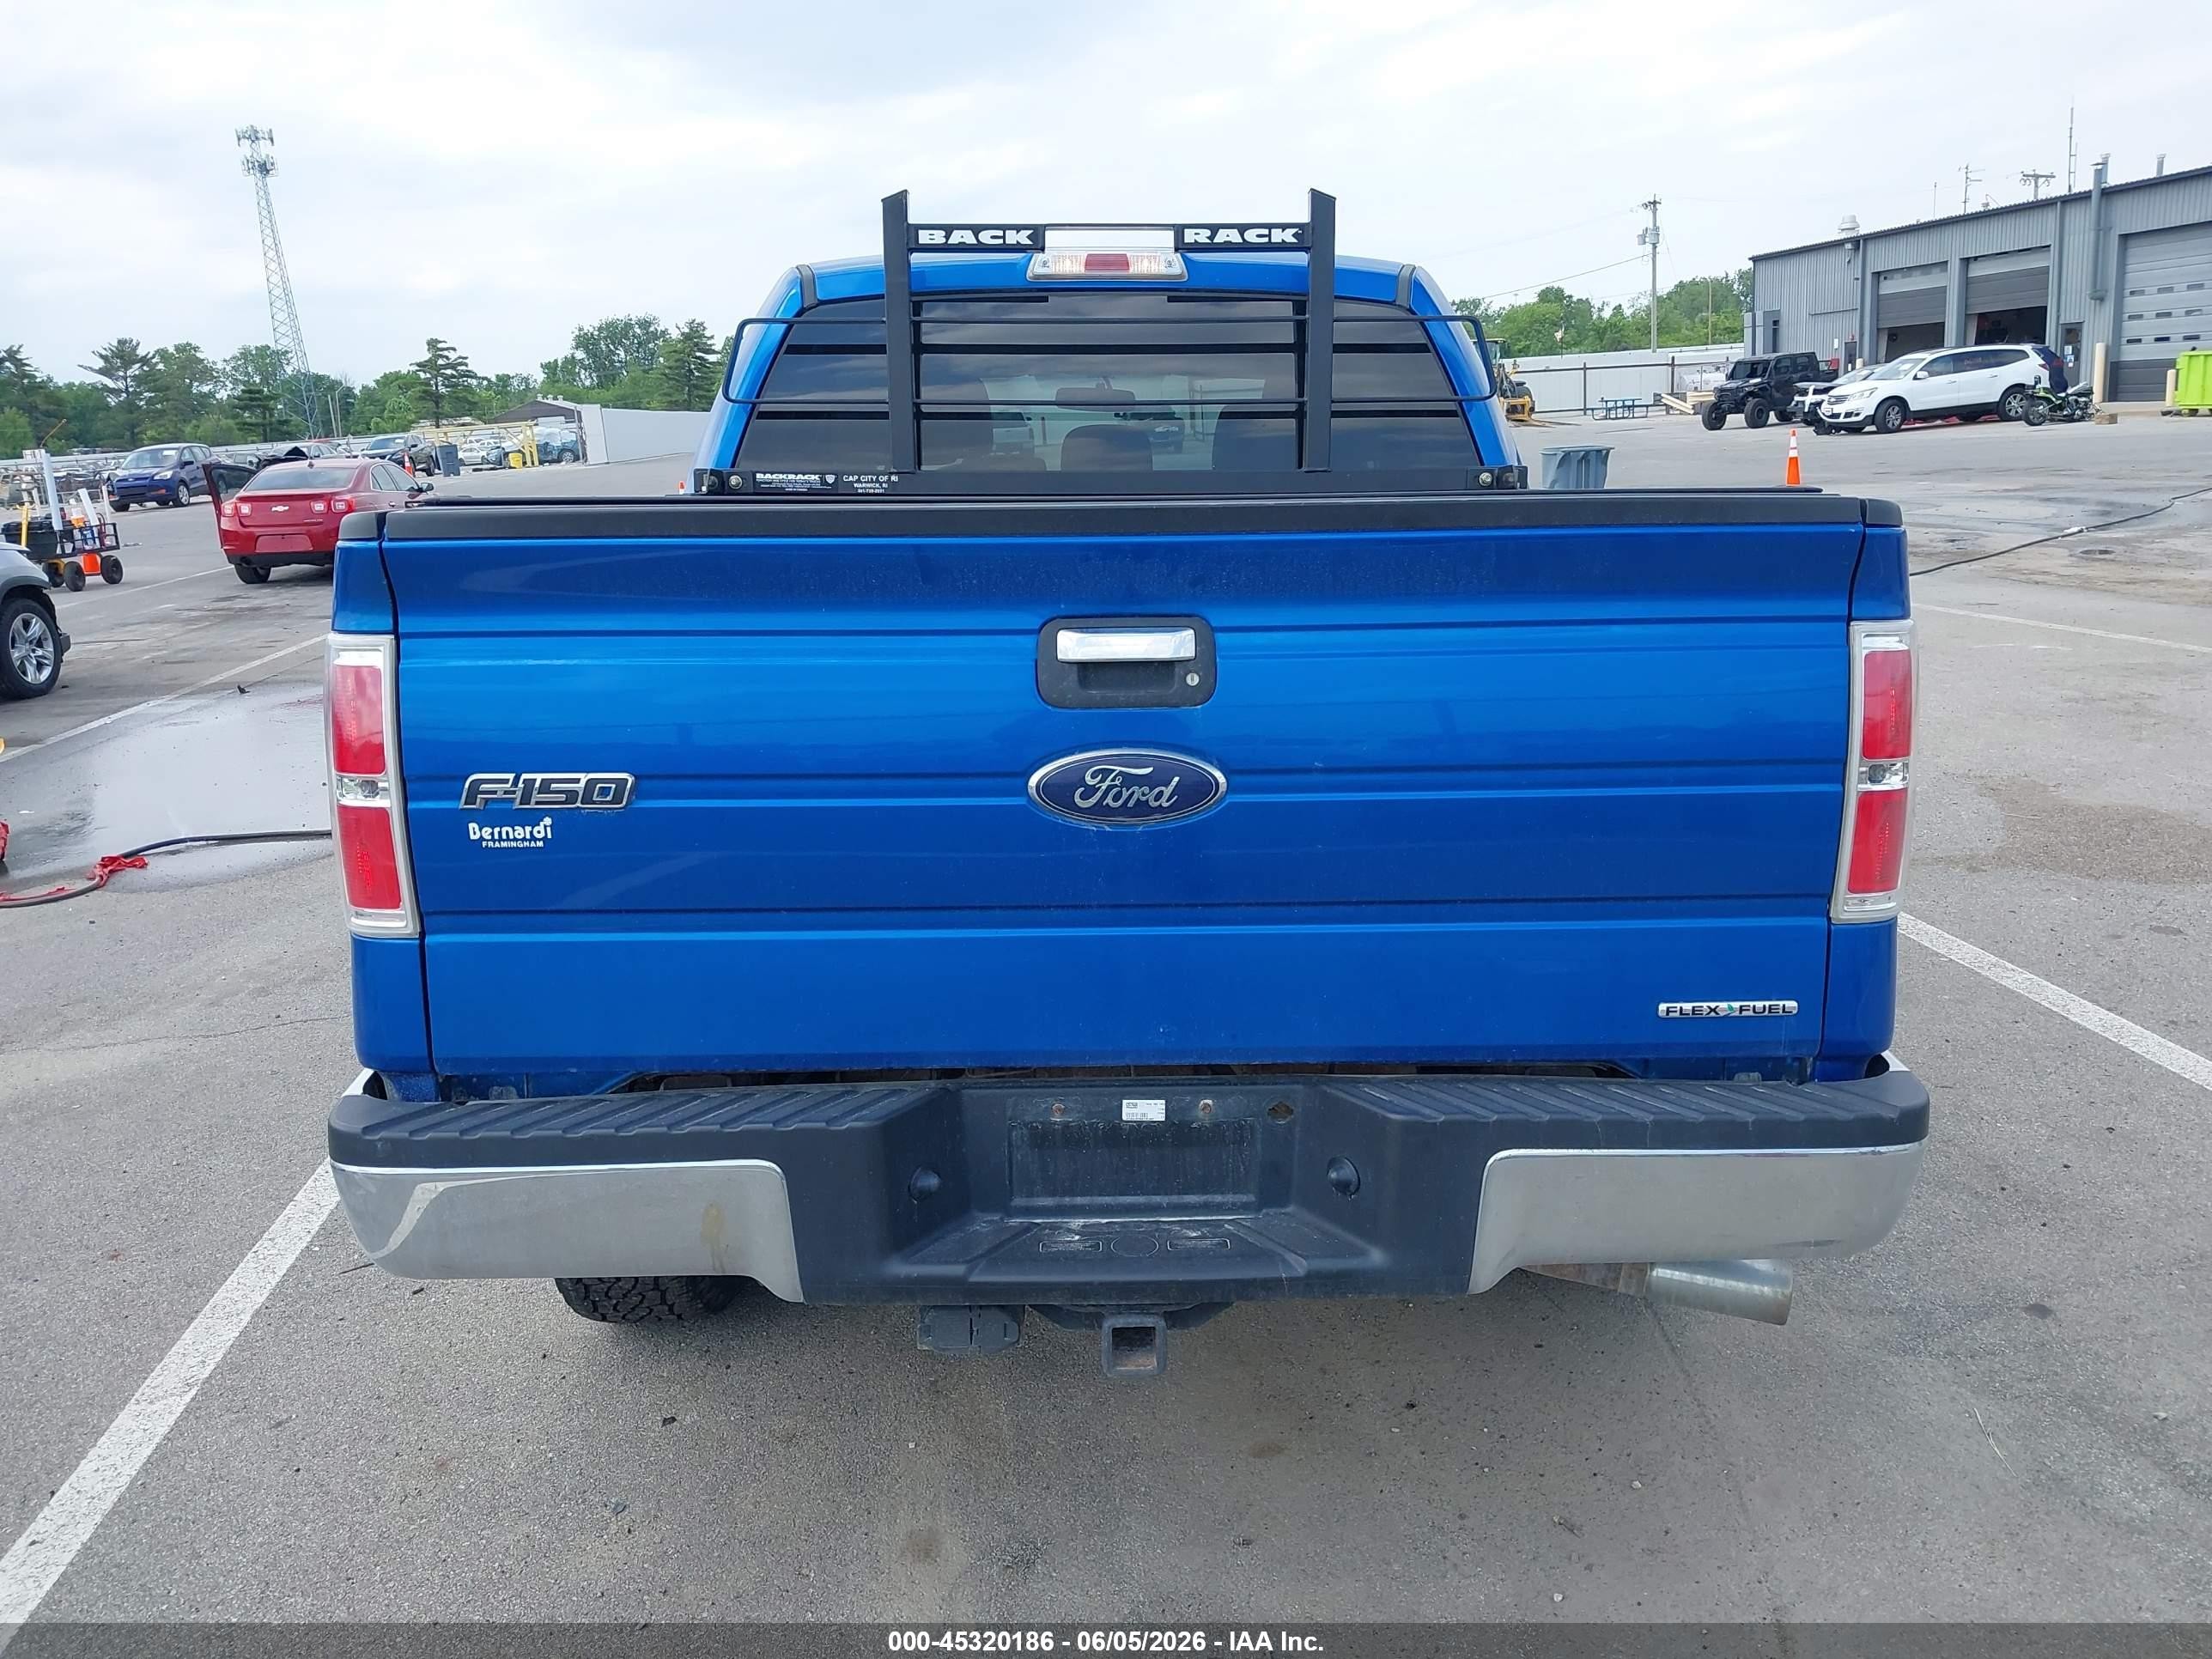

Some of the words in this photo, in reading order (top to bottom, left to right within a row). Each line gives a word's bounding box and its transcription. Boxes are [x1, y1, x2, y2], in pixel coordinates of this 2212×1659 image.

[918, 229, 1035, 246] BACK
[1183, 227, 1300, 243] RACK
[459, 773, 635, 810] F-150
[1074, 765, 1181, 808] Ford
[468, 817, 552, 841] Bernardi
[1665, 1005, 1721, 1017] FLEX
[1739, 1003, 1793, 1015] FUEL
